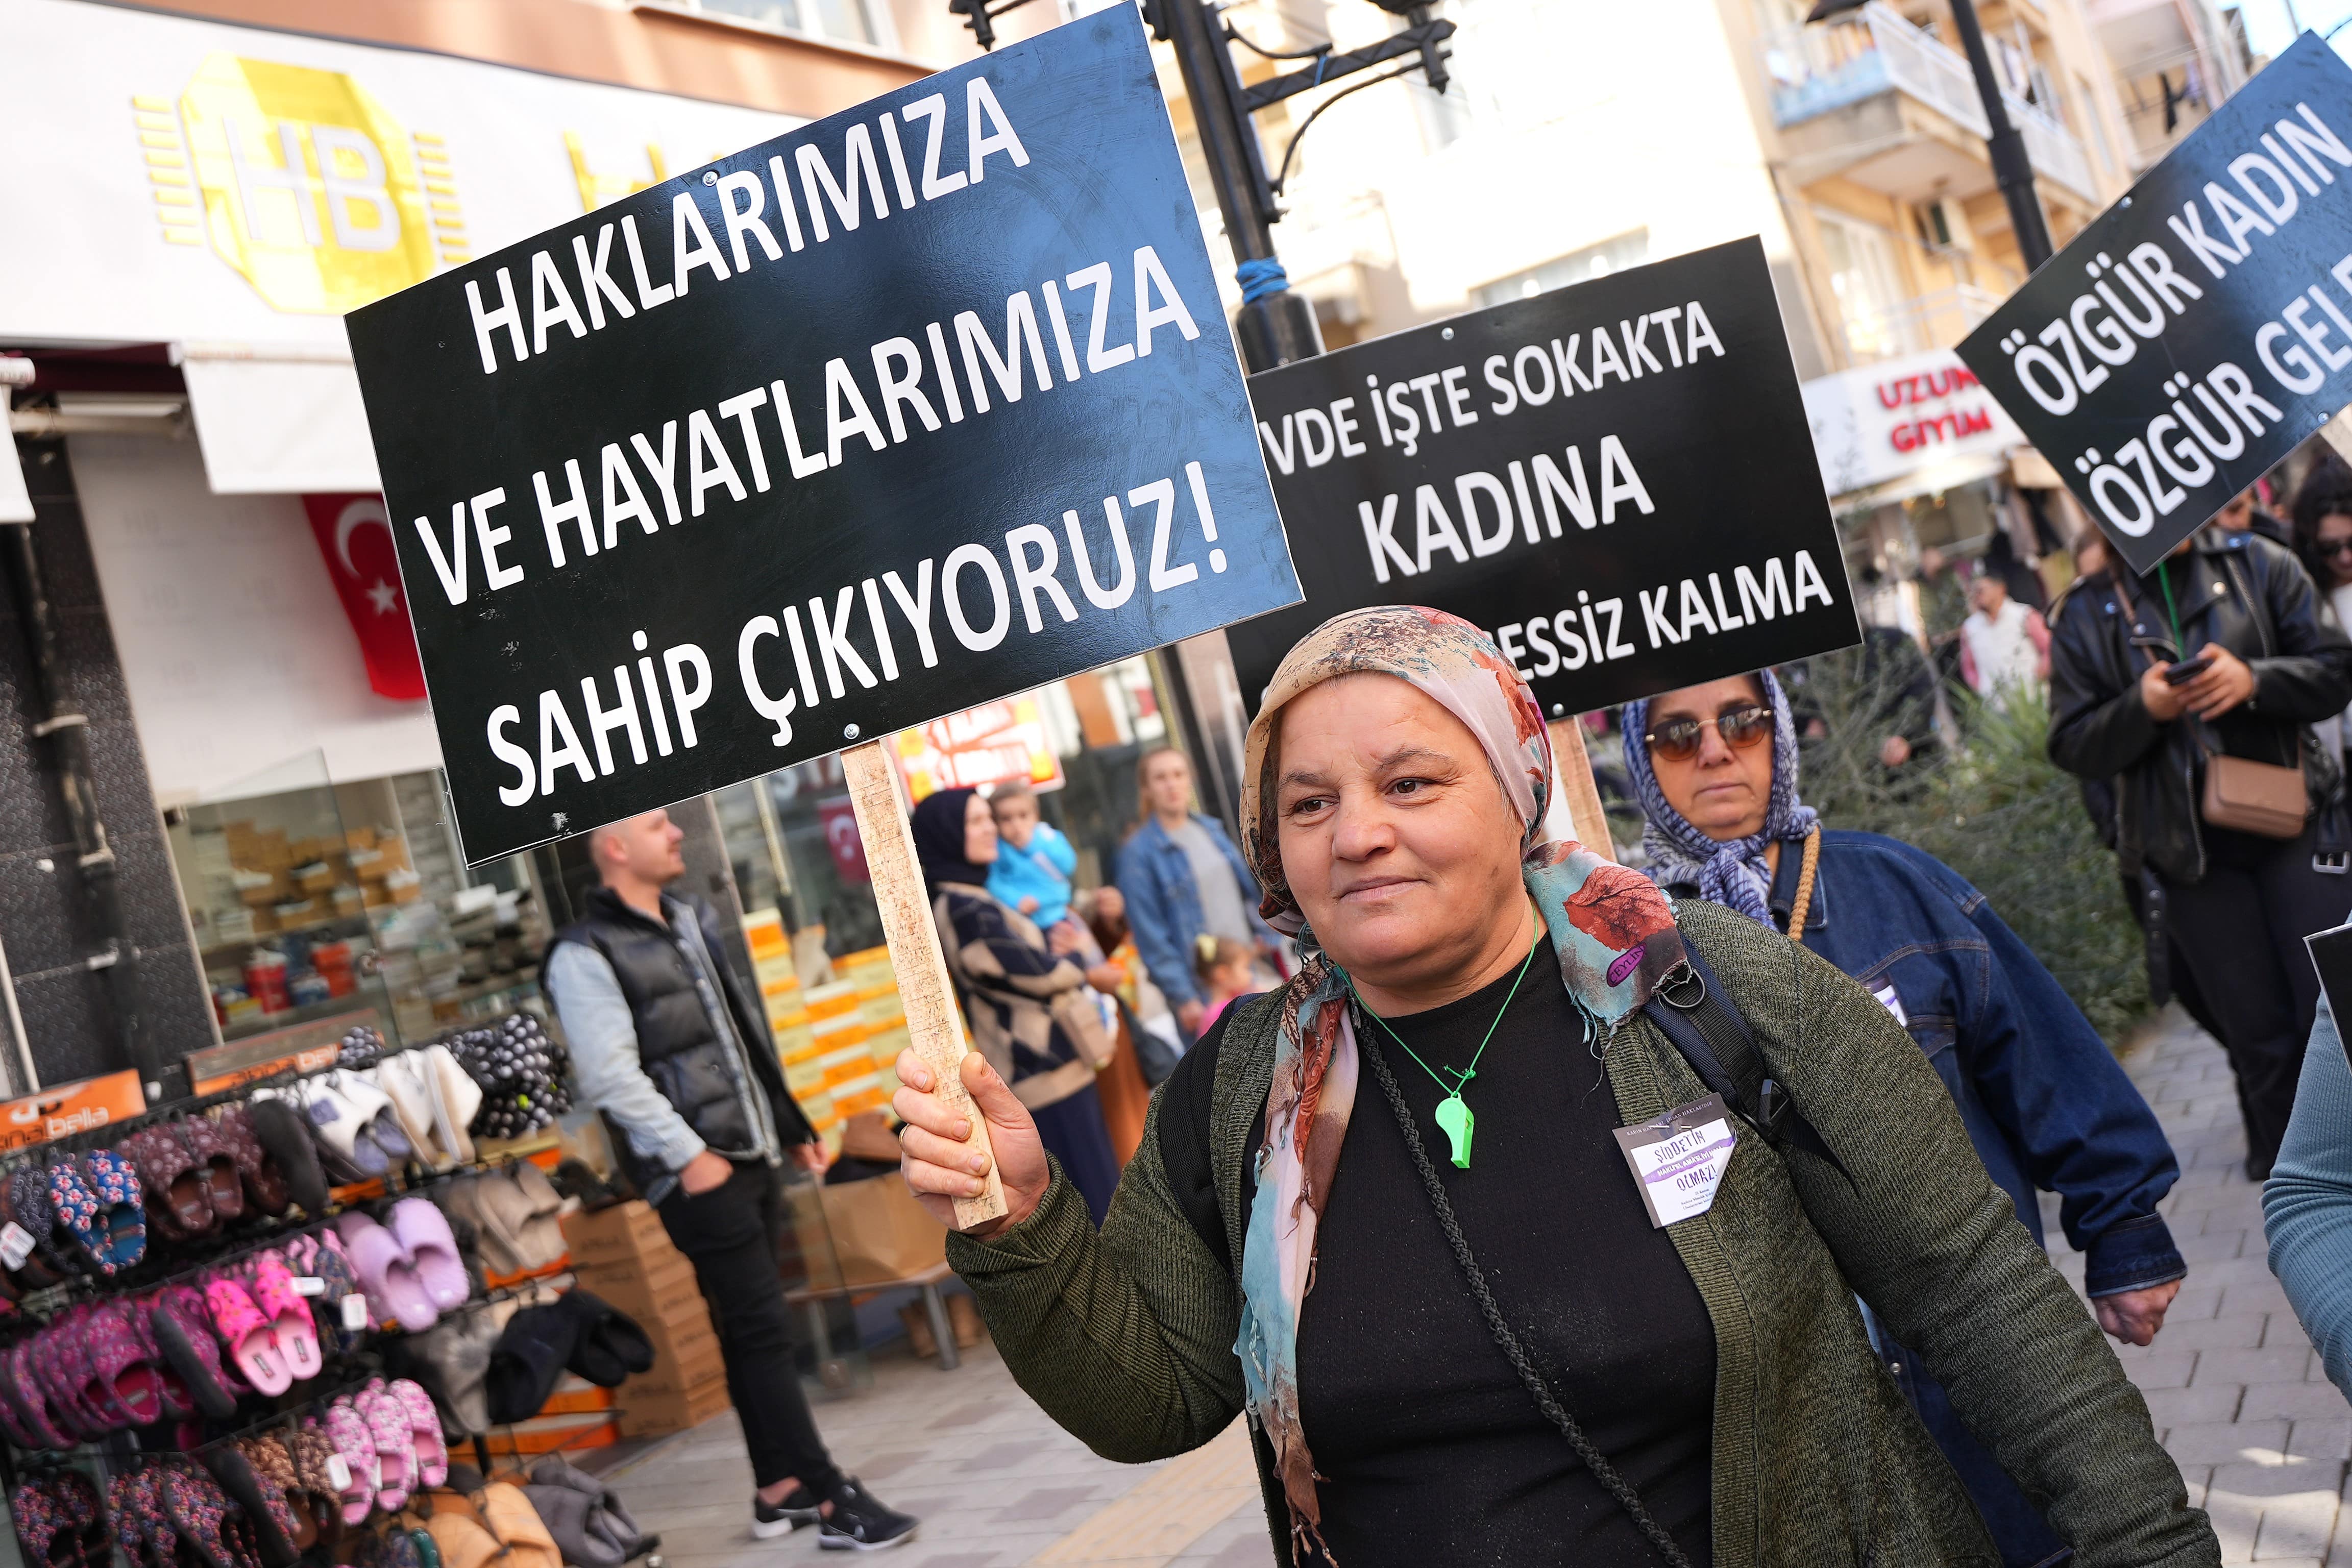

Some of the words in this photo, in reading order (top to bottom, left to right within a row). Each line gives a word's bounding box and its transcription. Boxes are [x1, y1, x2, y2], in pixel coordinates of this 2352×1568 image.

[223, 117, 401, 253] HB
[464, 76, 1030, 374] HAKLARIMIZA
[2000, 243, 2202, 415] ÖZGÜR
[2167, 103, 2352, 278] KADIN
[414, 487, 524, 605] VE
[532, 246, 1200, 568] HAYATLARIMIZA
[1258, 397, 1366, 476] VDE
[1366, 365, 1479, 456] İŞTE
[1484, 301, 1725, 415] SOKAKTA
[2075, 363, 2282, 536] ÖZGÜR
[1358, 434, 1655, 583] KADINA
[487, 630, 712, 806] SAHİP
[738, 461, 1227, 747] ÇIKIYORUZ!
[1482, 590, 1635, 681] ESSİZ
[1639, 550, 1833, 648] KALMA
[1654, 1129, 1706, 1163] ŞİDDETİN
[1676, 1164, 1718, 1191] OLMAZ!
